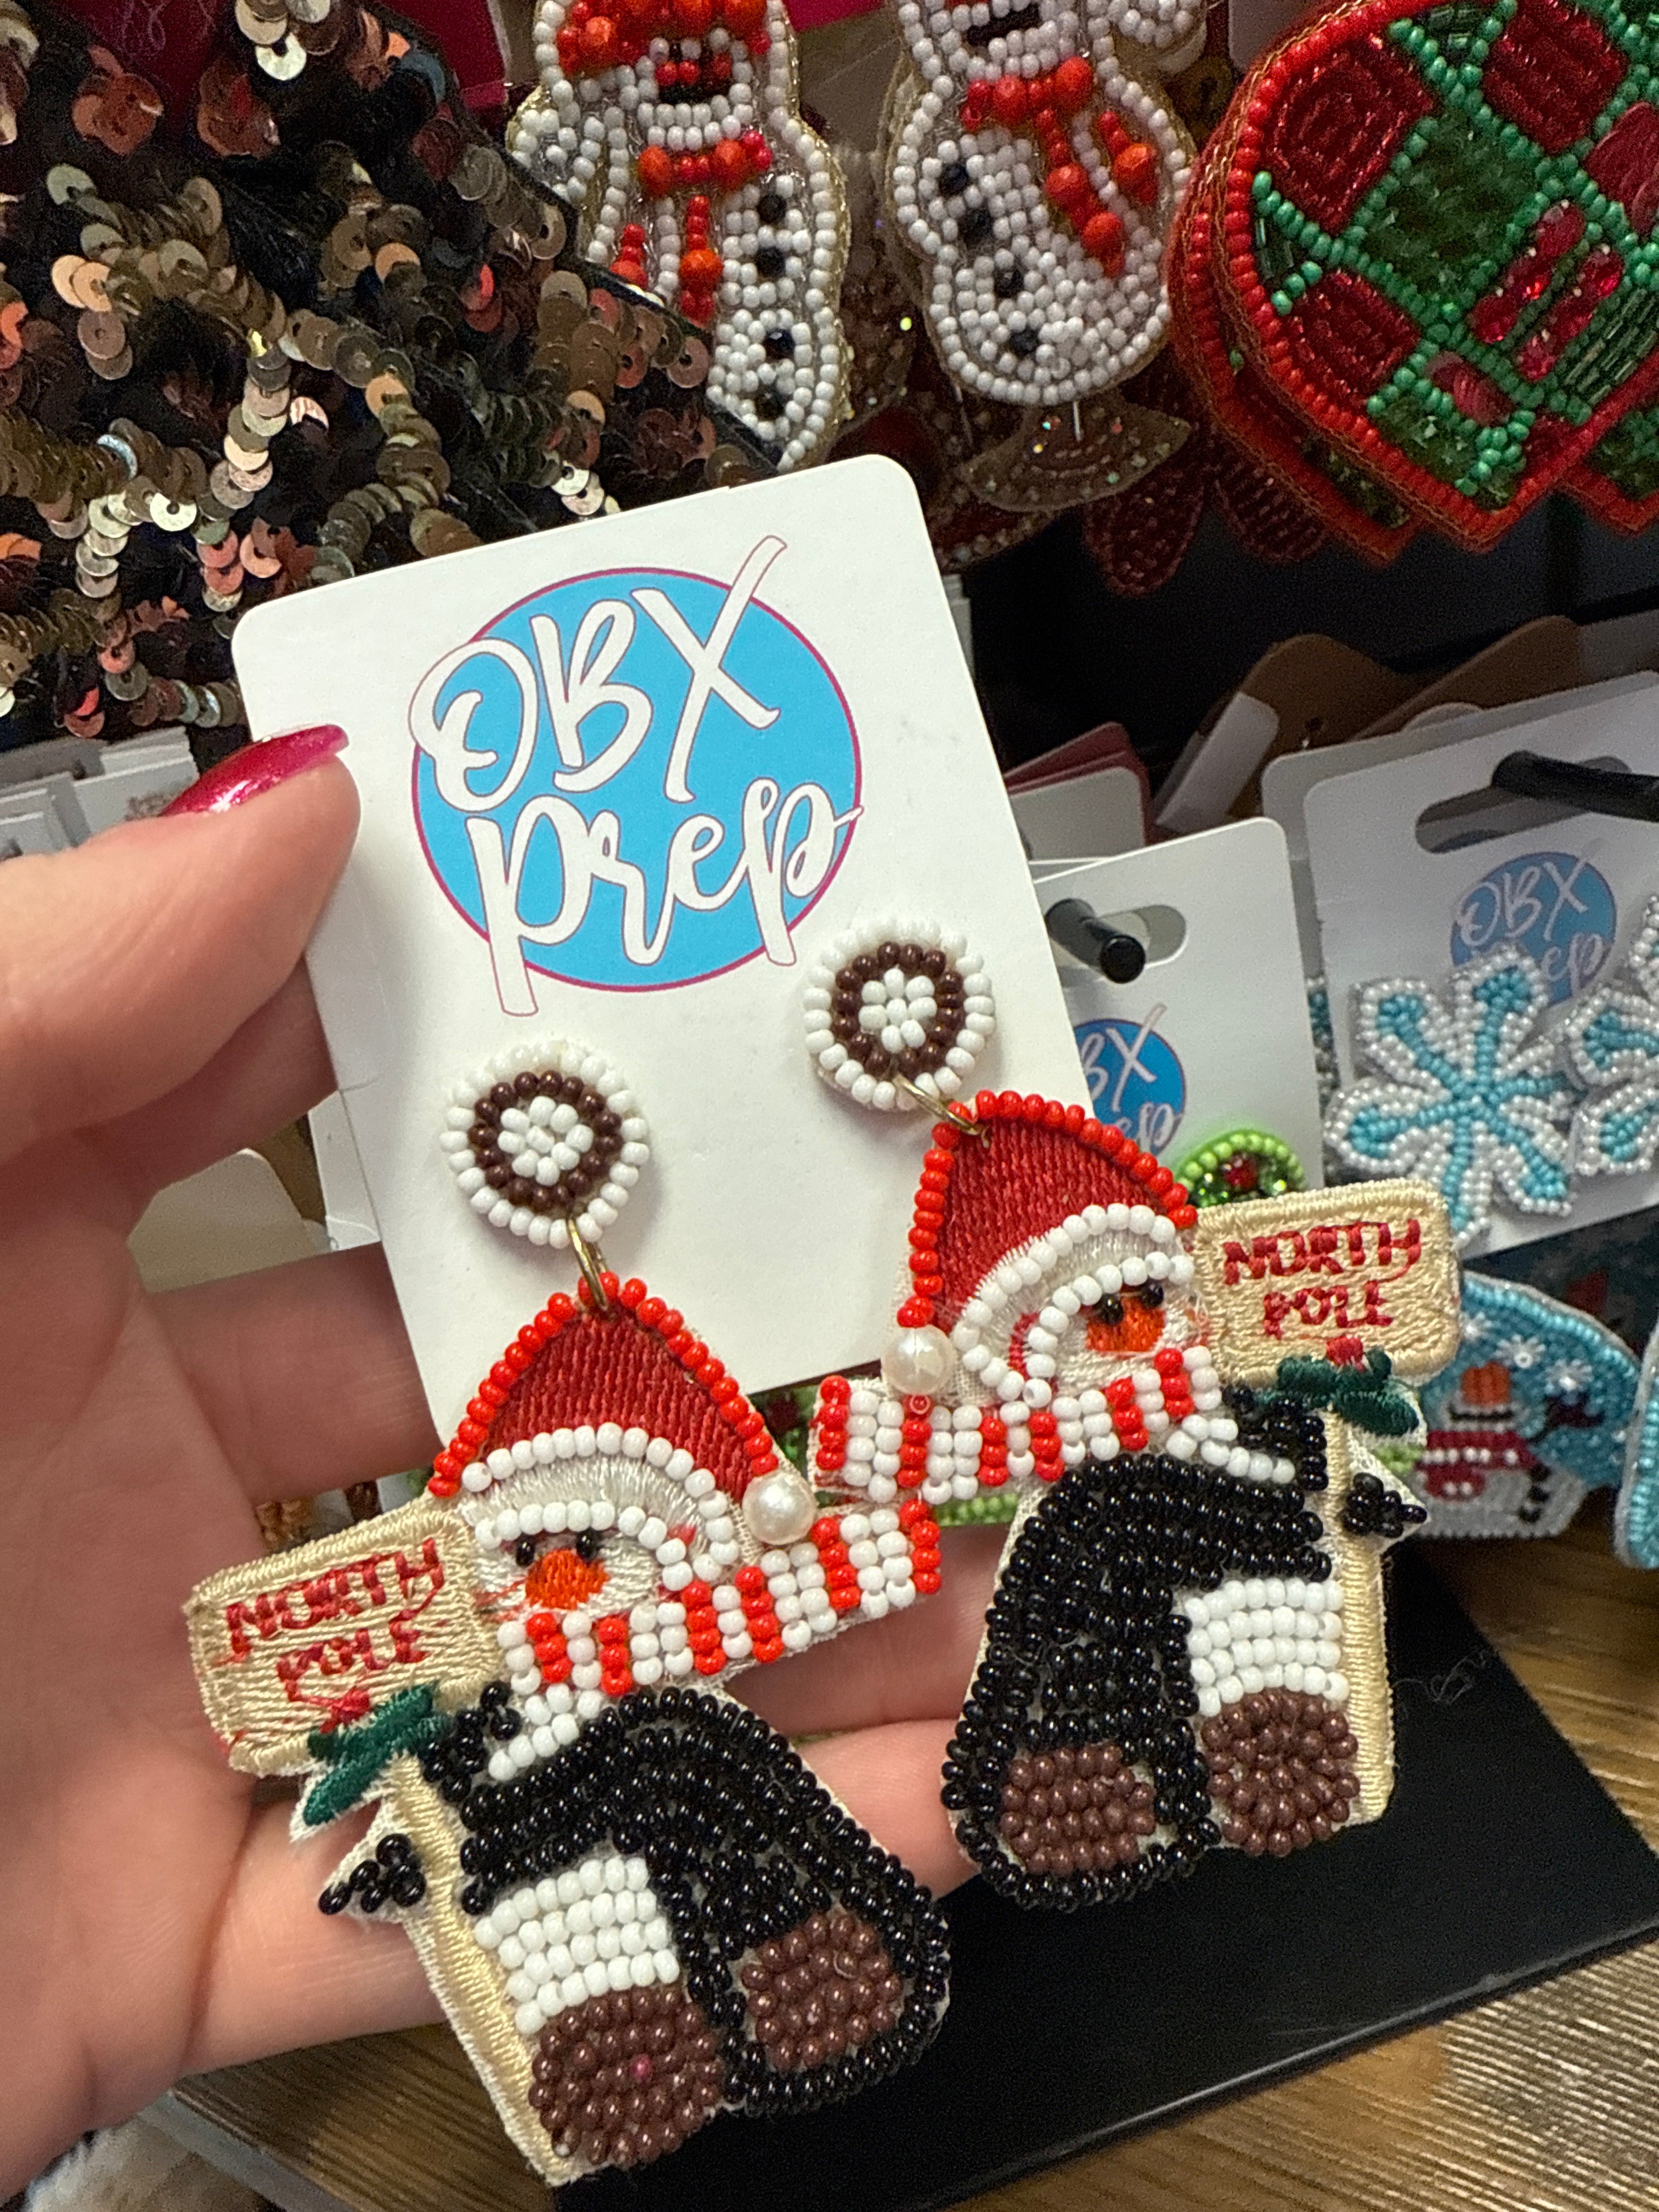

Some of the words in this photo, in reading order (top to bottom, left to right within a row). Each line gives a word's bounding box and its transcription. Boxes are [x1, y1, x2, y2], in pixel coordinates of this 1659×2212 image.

[408, 535, 787, 813] OBX
[1455, 838, 1608, 946] OBX
[1080, 1003, 1167, 1113] BX
[1223, 1218, 1422, 1285] NORTH
[225, 1537, 444, 1656] NORTH
